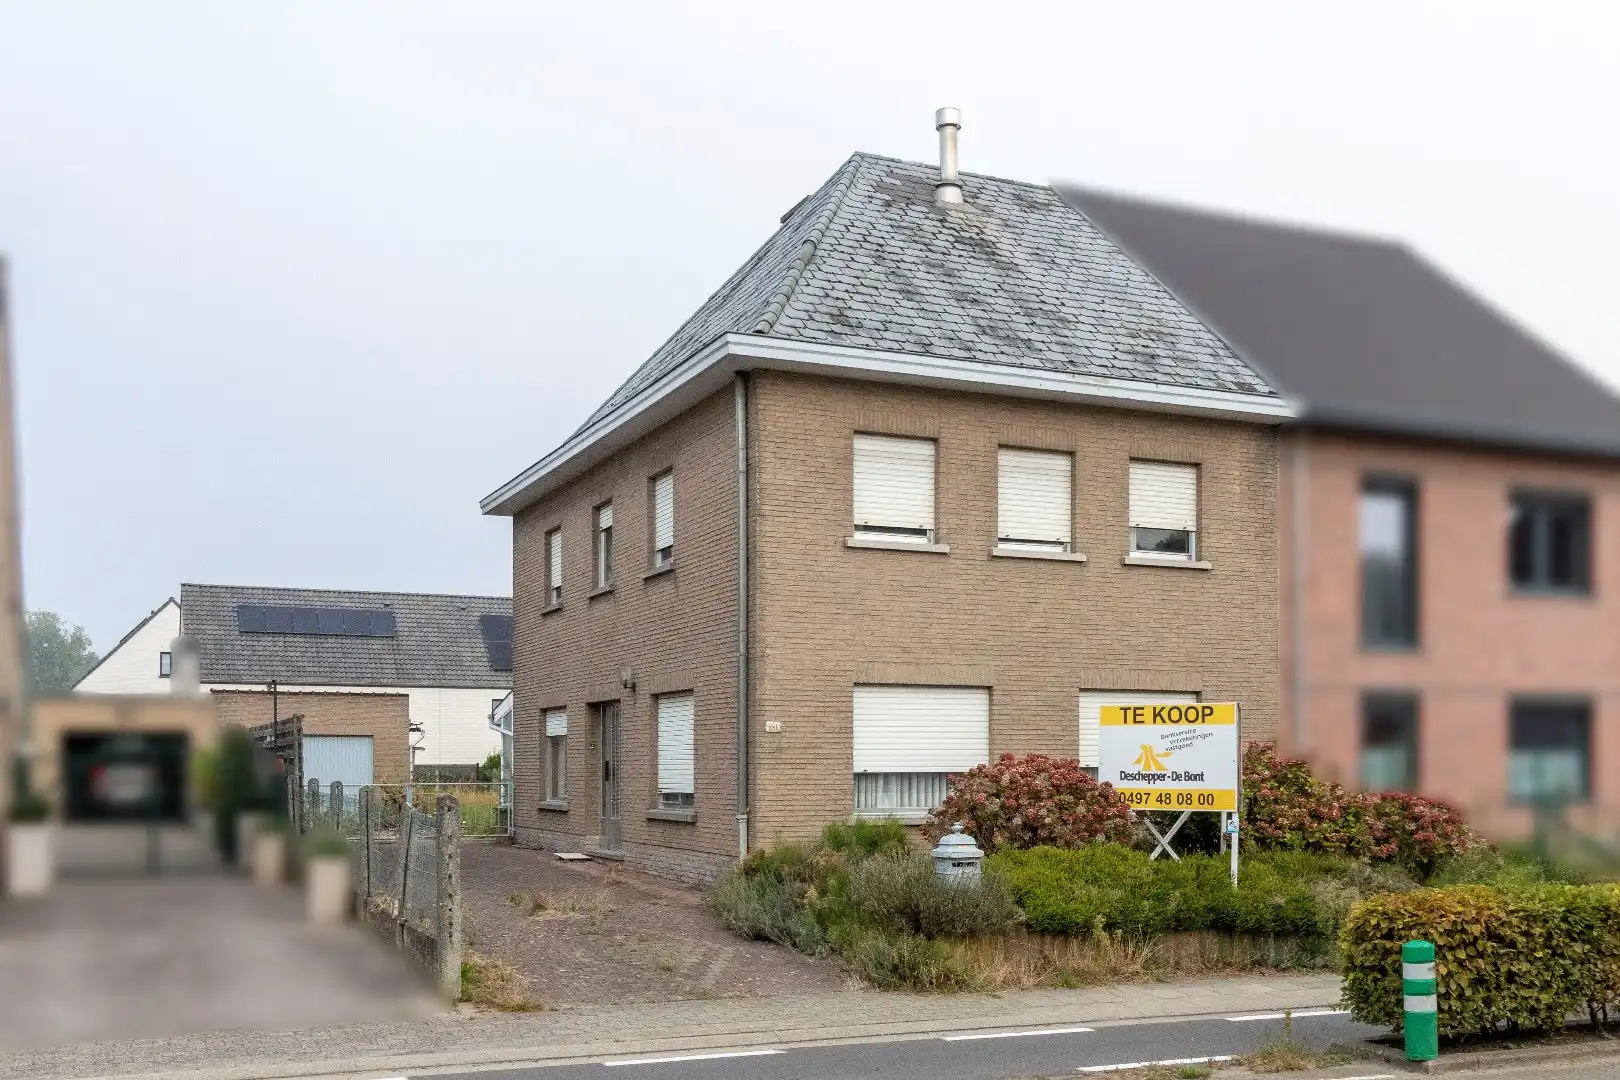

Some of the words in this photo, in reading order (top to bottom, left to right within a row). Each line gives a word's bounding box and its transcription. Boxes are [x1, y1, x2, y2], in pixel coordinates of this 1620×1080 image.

[1120, 706, 1145, 724] TE
[1152, 705, 1214, 724] KOOP
[1120, 771, 1167, 784] Deschepper
[1171, 772, 1183, 781] De
[1184, 771, 1205, 782] Bont
[1119, 792, 1151, 805] 0497
[1155, 793, 1172, 806] 48
[1176, 793, 1193, 806] 08
[1197, 793, 1215, 806] 00
